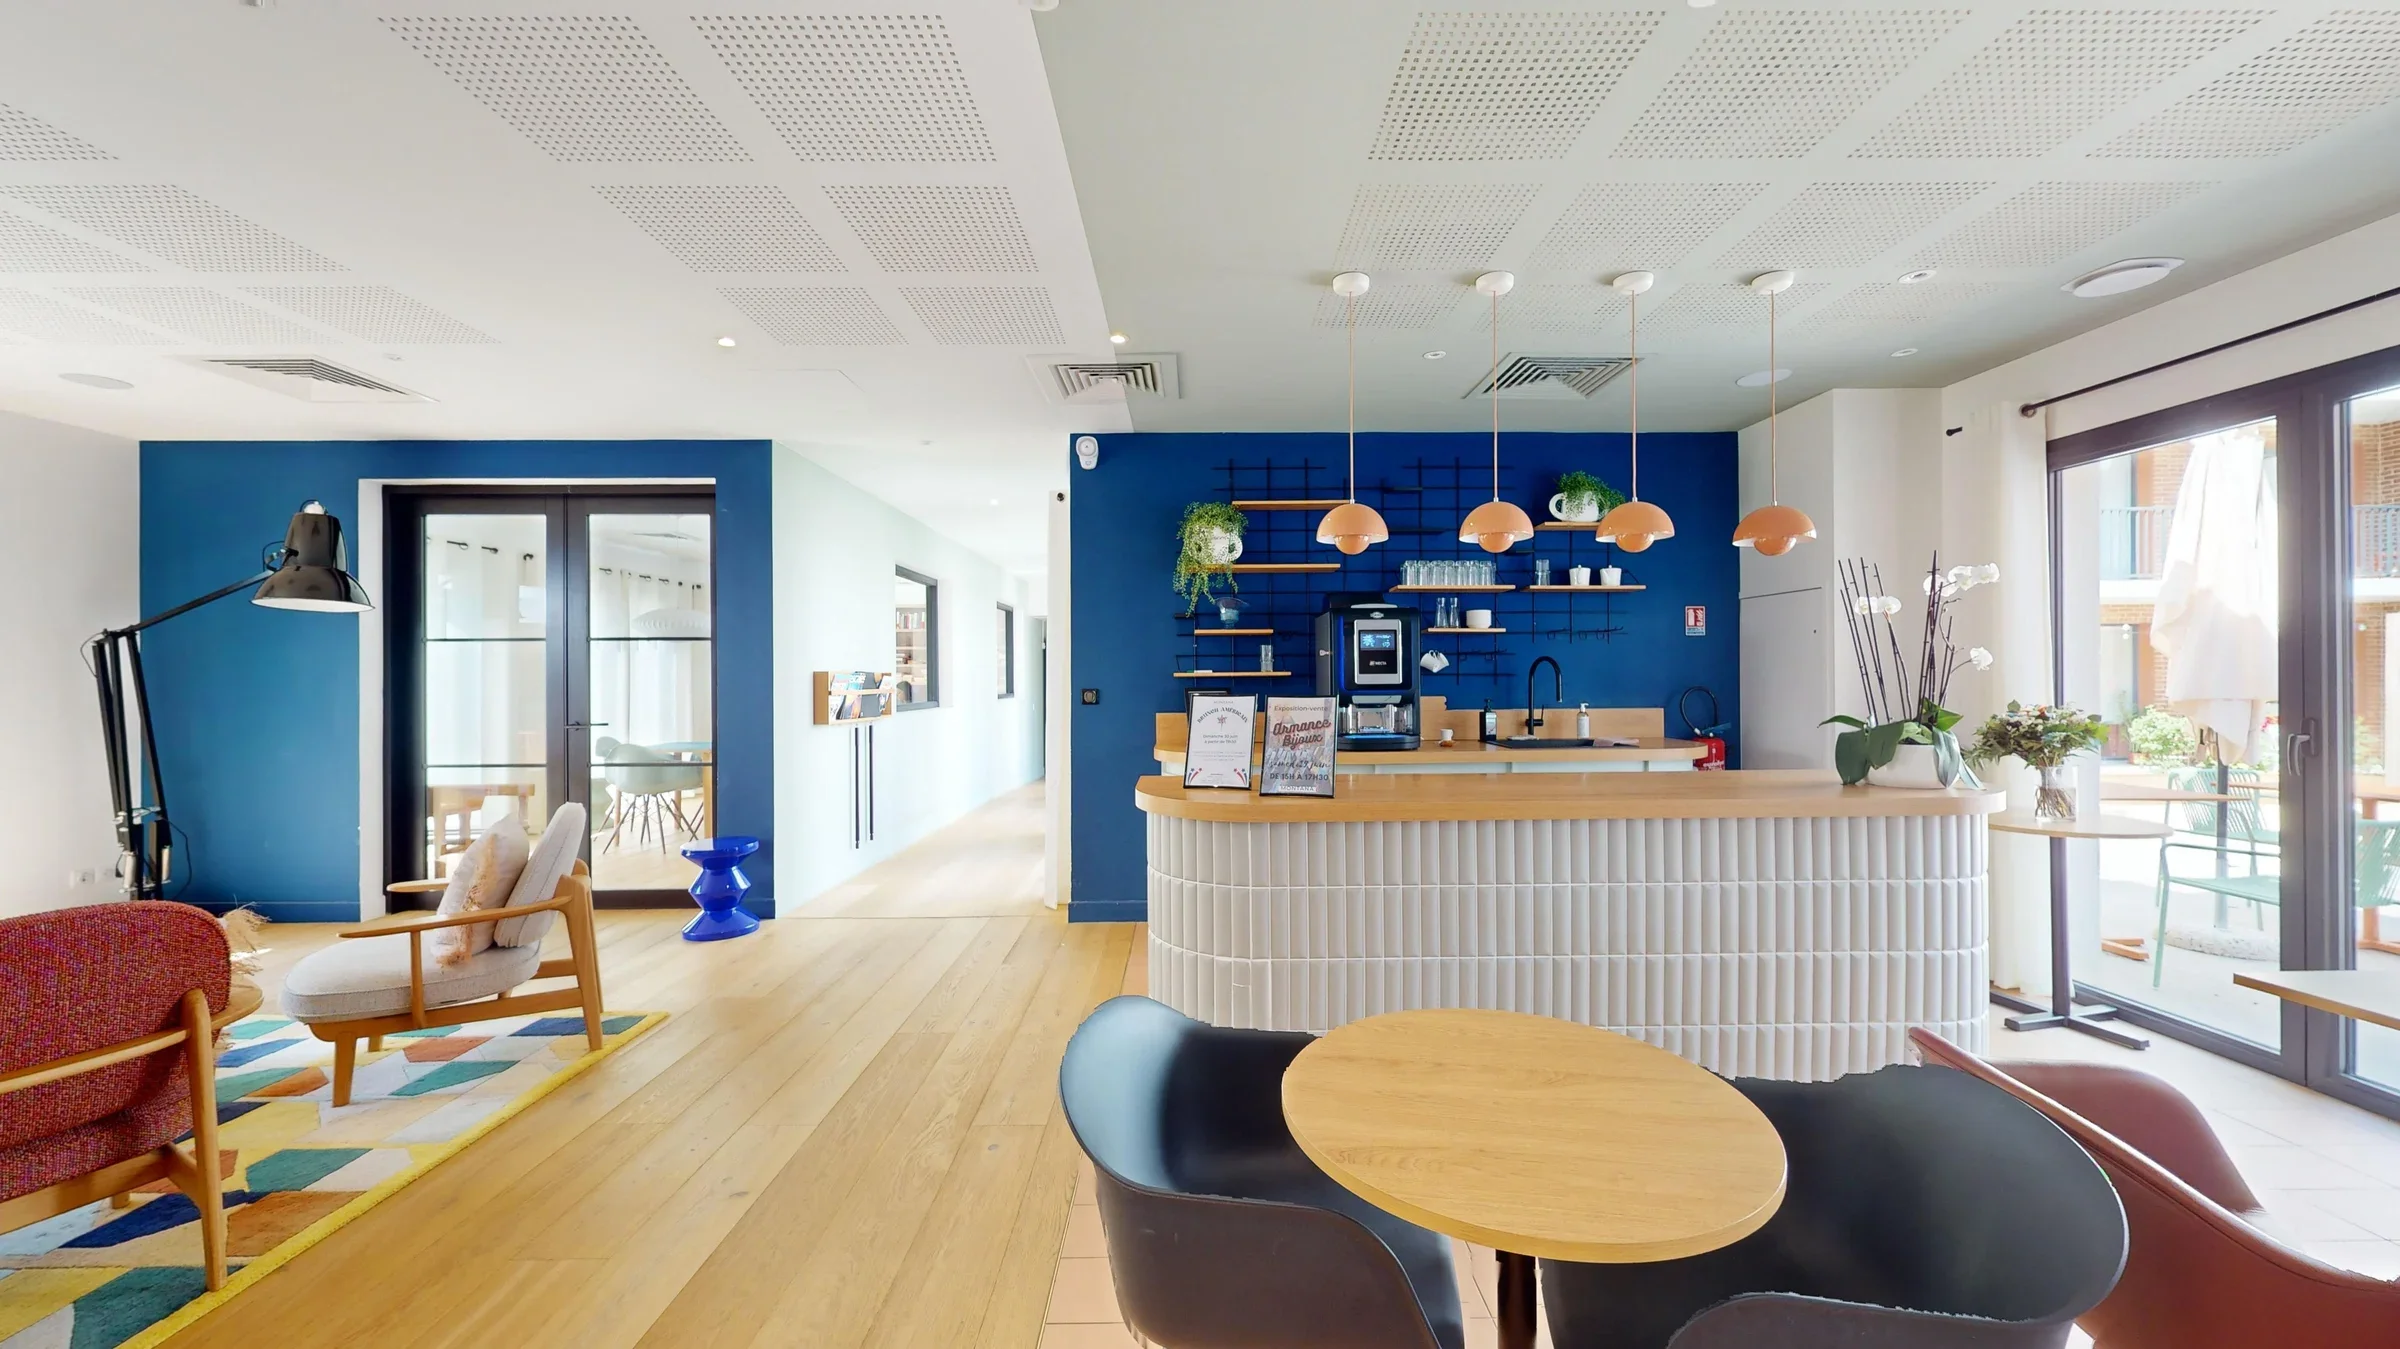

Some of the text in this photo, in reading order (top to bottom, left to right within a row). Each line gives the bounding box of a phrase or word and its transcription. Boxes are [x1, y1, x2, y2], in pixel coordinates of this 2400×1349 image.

[1273, 719, 1331, 736] Armance
[1282, 733, 1323, 750] Bijoux
[1304, 773, 1329, 781] 17H30
